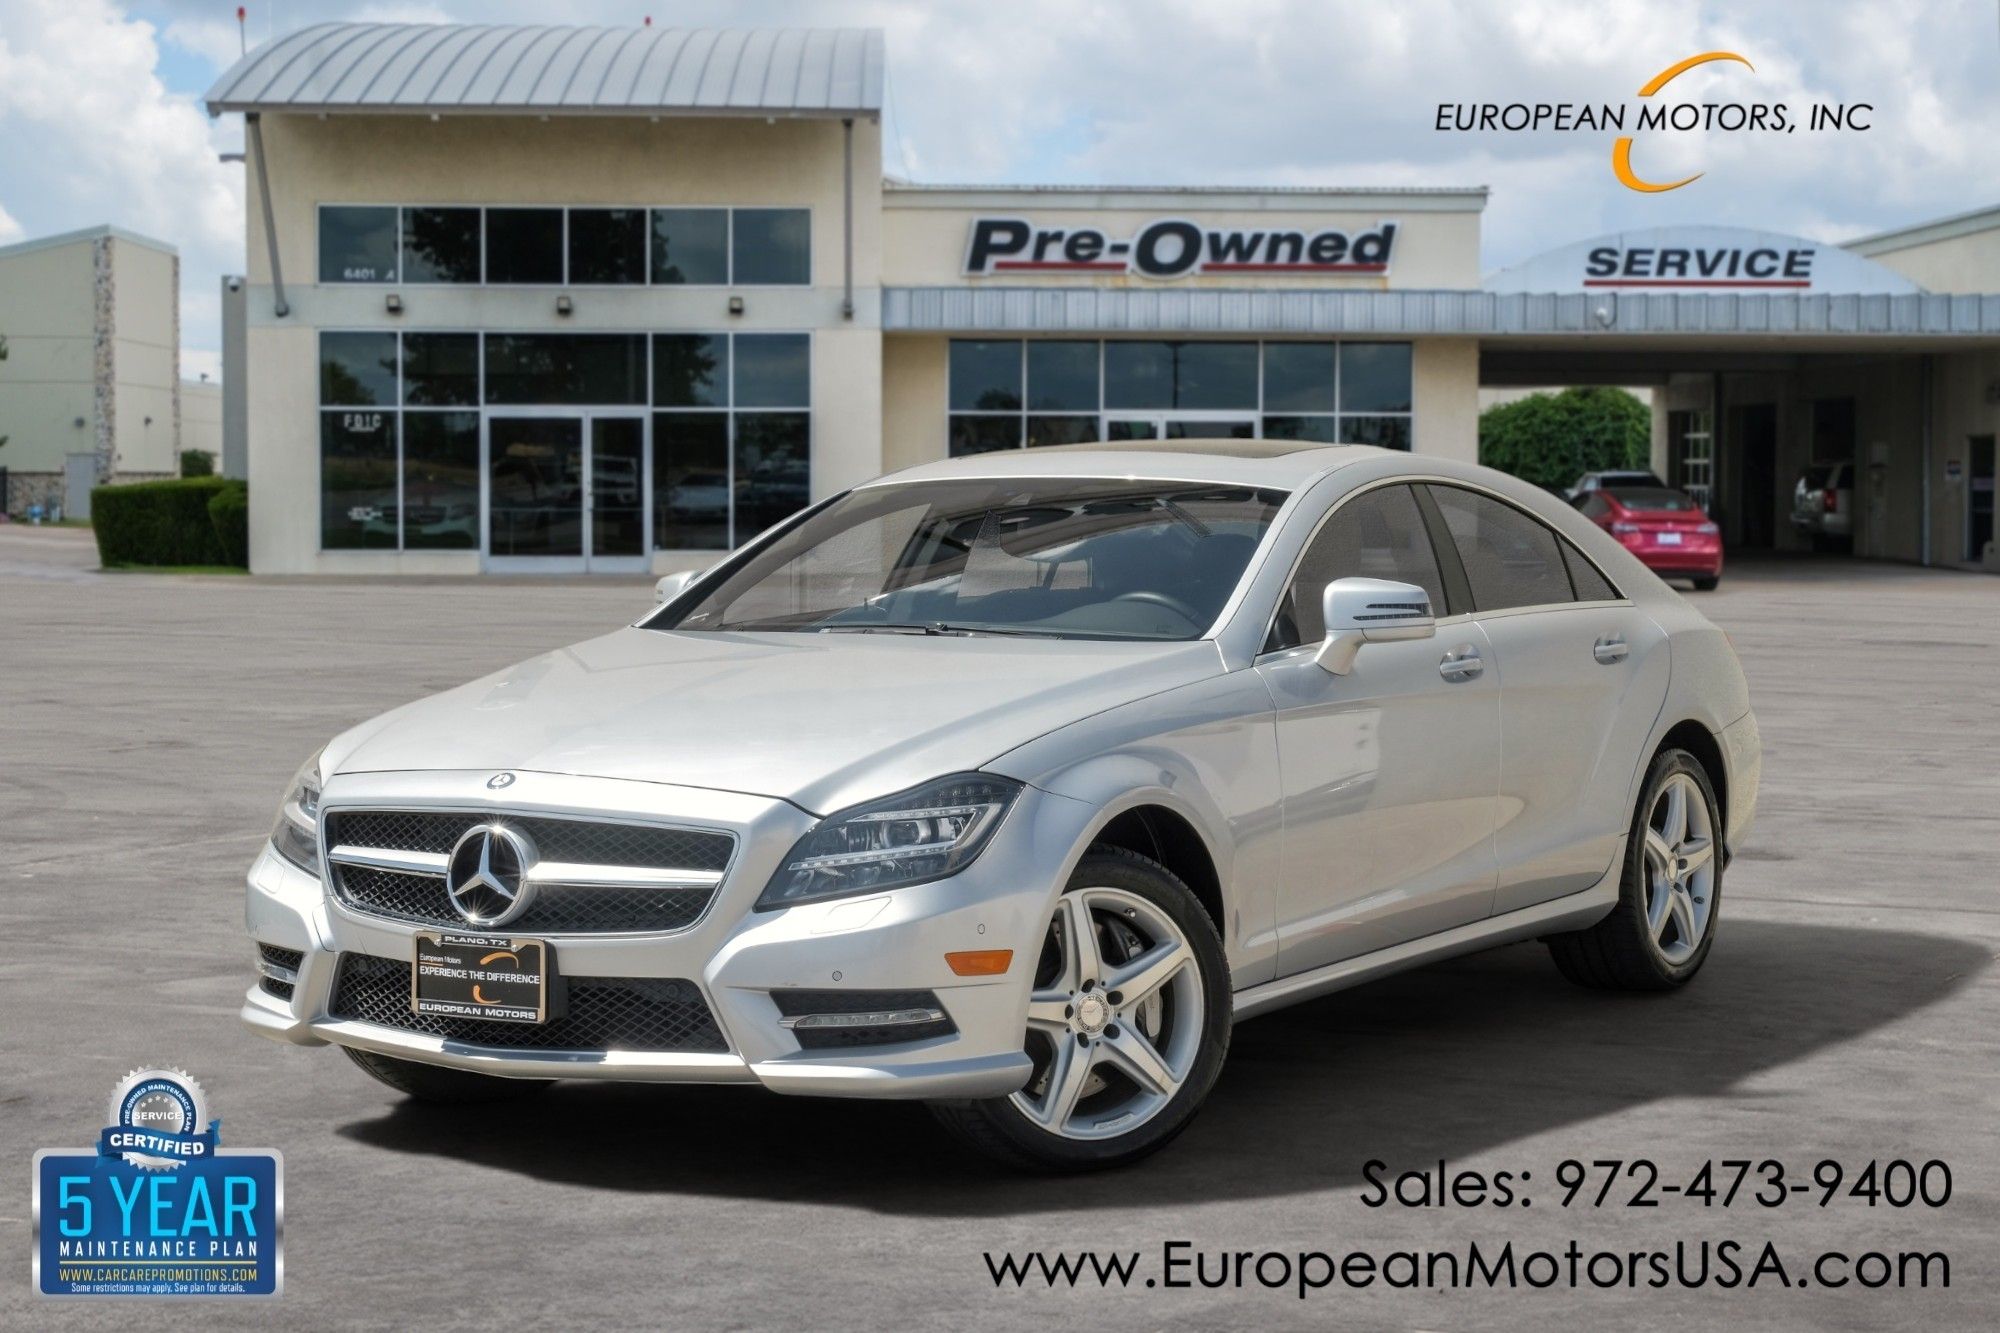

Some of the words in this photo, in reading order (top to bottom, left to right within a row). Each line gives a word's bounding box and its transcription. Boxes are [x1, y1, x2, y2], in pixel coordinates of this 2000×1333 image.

[967, 219, 1397, 275] Pre-Owned
[1586, 247, 1815, 278] SERVICE
[444, 935, 488, 946] PLANO,
[490, 939, 508, 947] TX
[420, 966, 468, 979] EXPERIENCE
[469, 970, 486, 981] THE
[487, 973, 541, 985] DIFFERENCE
[419, 1002, 481, 1015] EUROPEAN
[485, 1008, 537, 1020] MOTORS
